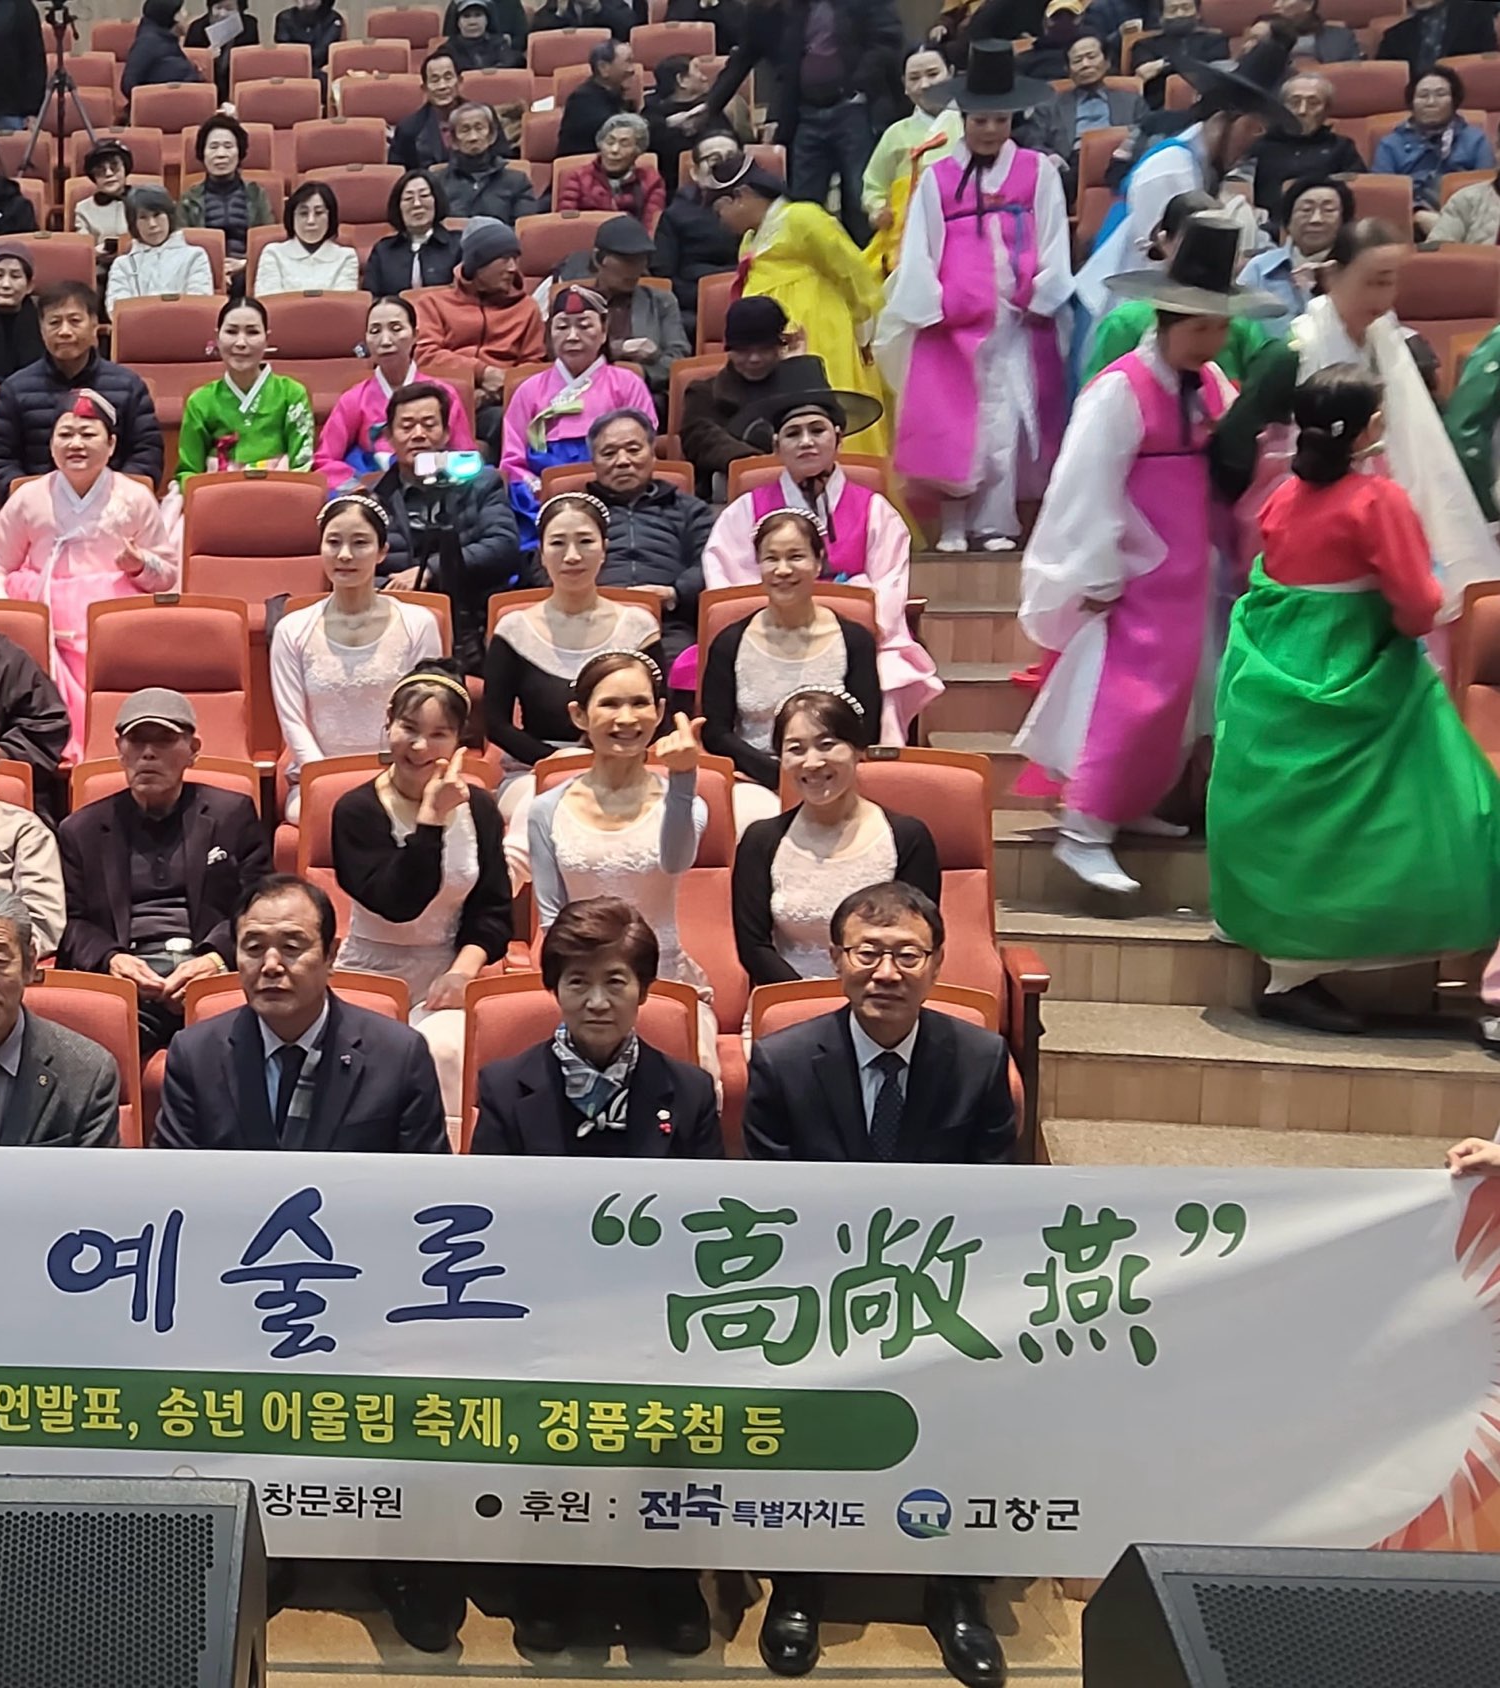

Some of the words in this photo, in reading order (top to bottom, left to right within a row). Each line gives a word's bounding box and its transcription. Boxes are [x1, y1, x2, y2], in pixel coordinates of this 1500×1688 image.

[45, 1186, 531, 1360] 예술로
[156, 1386, 245, 1439] 송년
[261, 1390, 395, 1444] 어울림
[411, 1392, 520, 1456] 축제,
[537, 1399, 725, 1455] 경품추첨
[740, 1405, 786, 1456] 등
[263, 1483, 402, 1519] 창문화원
[518, 1489, 591, 1524] 후원
[637, 1481, 731, 1532] 전북
[730, 1498, 867, 1530] 특별자치도
[962, 1496, 1081, 1533] 고창군
